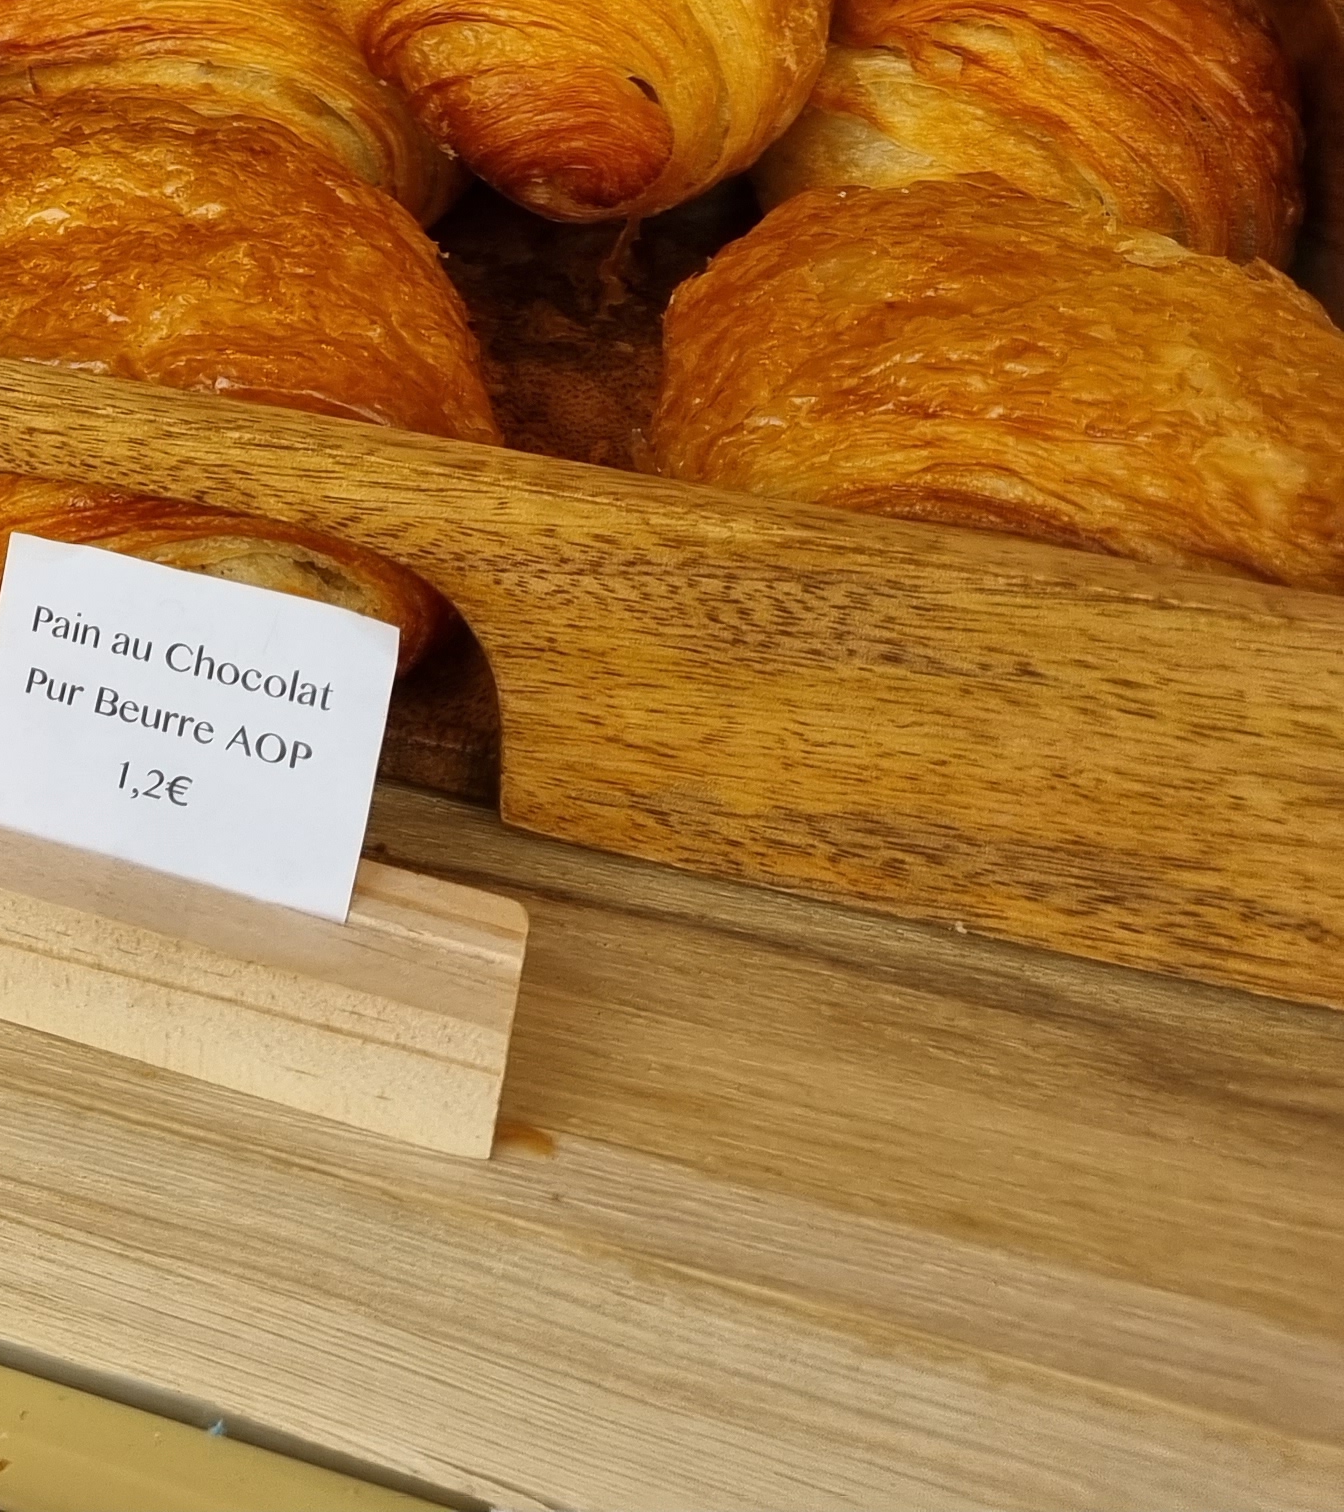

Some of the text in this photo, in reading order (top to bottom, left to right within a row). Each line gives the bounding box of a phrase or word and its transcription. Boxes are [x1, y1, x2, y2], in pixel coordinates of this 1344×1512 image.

[32, 605, 334, 710] Pain au Chocolat
[25, 667, 312, 769] Pur Beurre AOP
[117, 760, 193, 806] 1,2€
